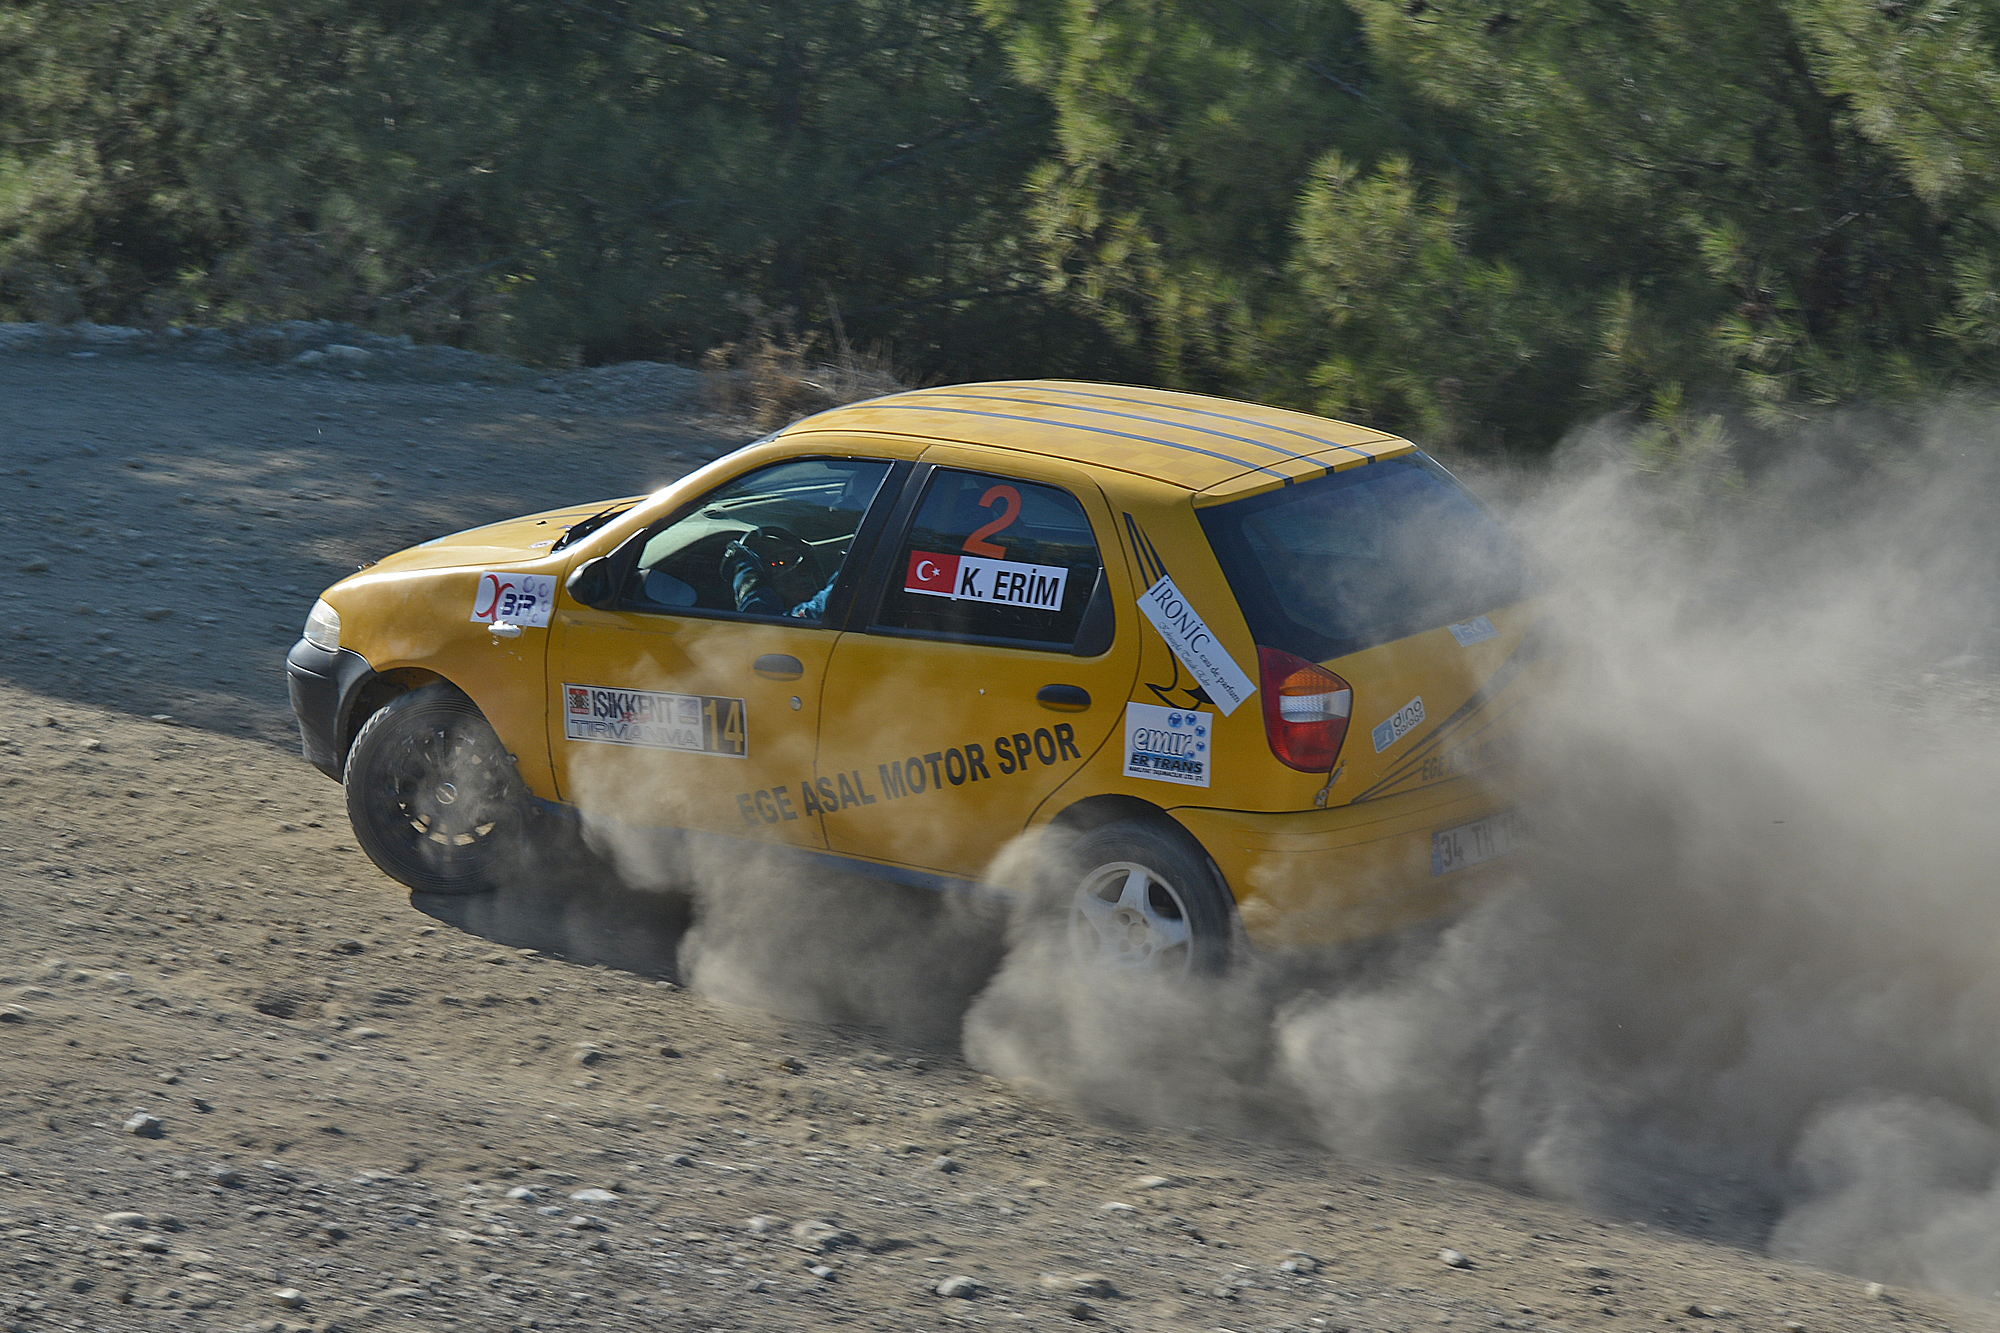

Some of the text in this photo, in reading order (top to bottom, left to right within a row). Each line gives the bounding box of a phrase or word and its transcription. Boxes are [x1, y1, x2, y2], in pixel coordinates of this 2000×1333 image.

[962, 485, 1022, 559] 2
[960, 567, 1060, 606] K. ERİM
[1209, 664, 1221, 677] de
[1218, 676, 1241, 704] parfum
[704, 699, 744, 753] 14
[1393, 700, 1422, 728] dino
[1395, 710, 1424, 738] garage
[735, 722, 1081, 827] EGE ASAL MOTOR SPOR
[1130, 752, 1204, 775] ER TRANS
[1440, 833, 1464, 868] 34
